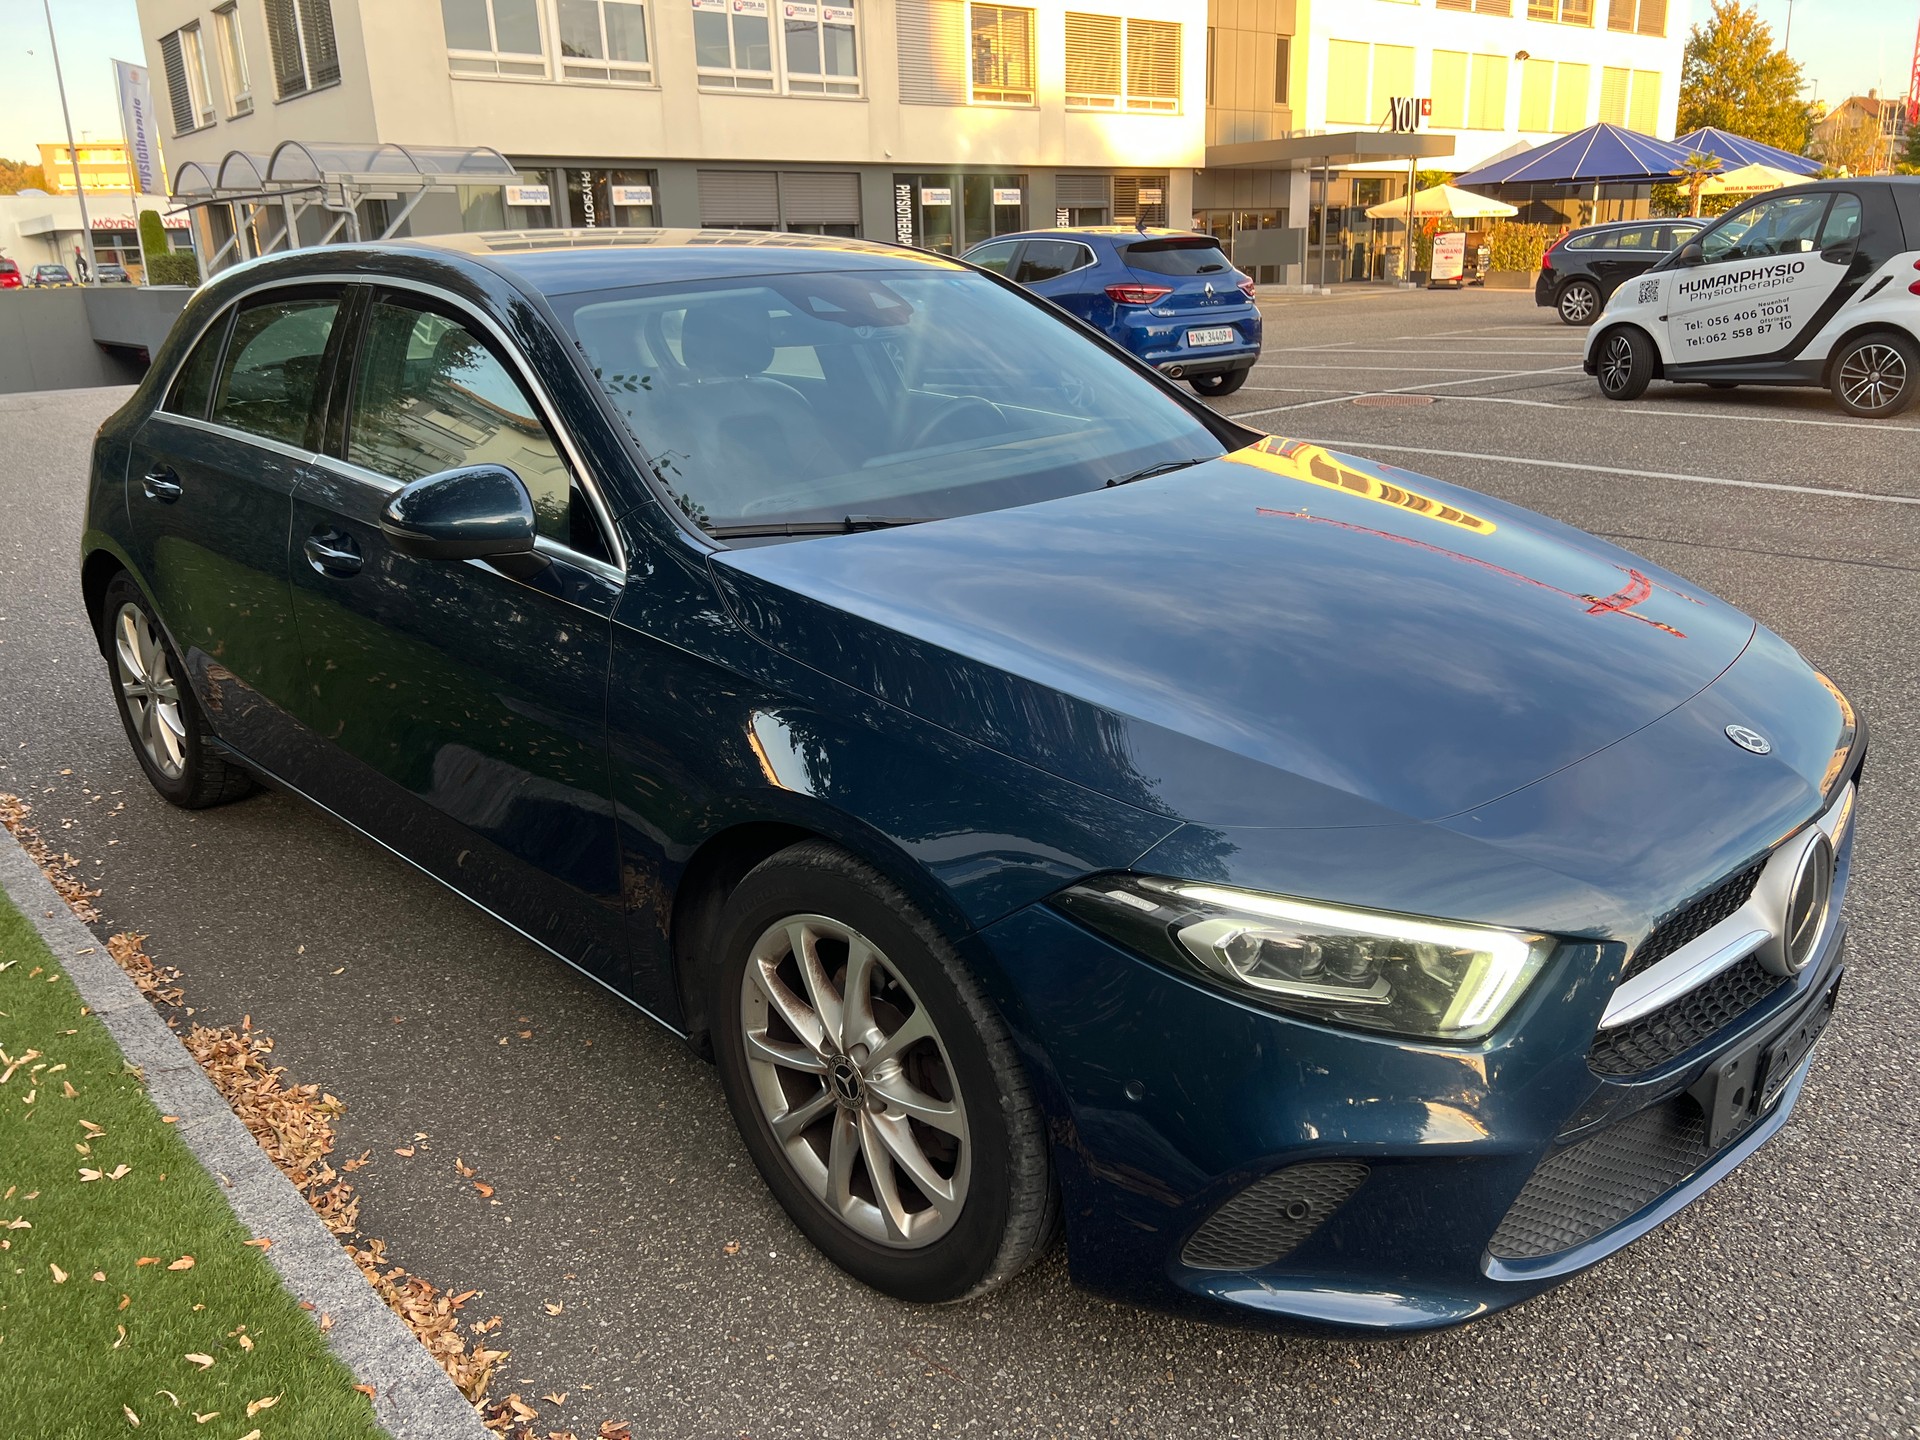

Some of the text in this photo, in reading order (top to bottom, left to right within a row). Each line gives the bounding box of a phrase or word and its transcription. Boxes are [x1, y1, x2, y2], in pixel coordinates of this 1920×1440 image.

[1390, 97, 1420, 132] YOU
[1679, 261, 1805, 295] HUMANPHYSIO
[1690, 275, 1795, 302] Physiotherapie
[1758, 297, 1790, 308] Neuenhof
[1685, 303, 1789, 331] Tel: 056 406 1001
[1760, 315, 1791, 324] Oftringen
[1686, 320, 1792, 347] Tel: 062 558 87 10
